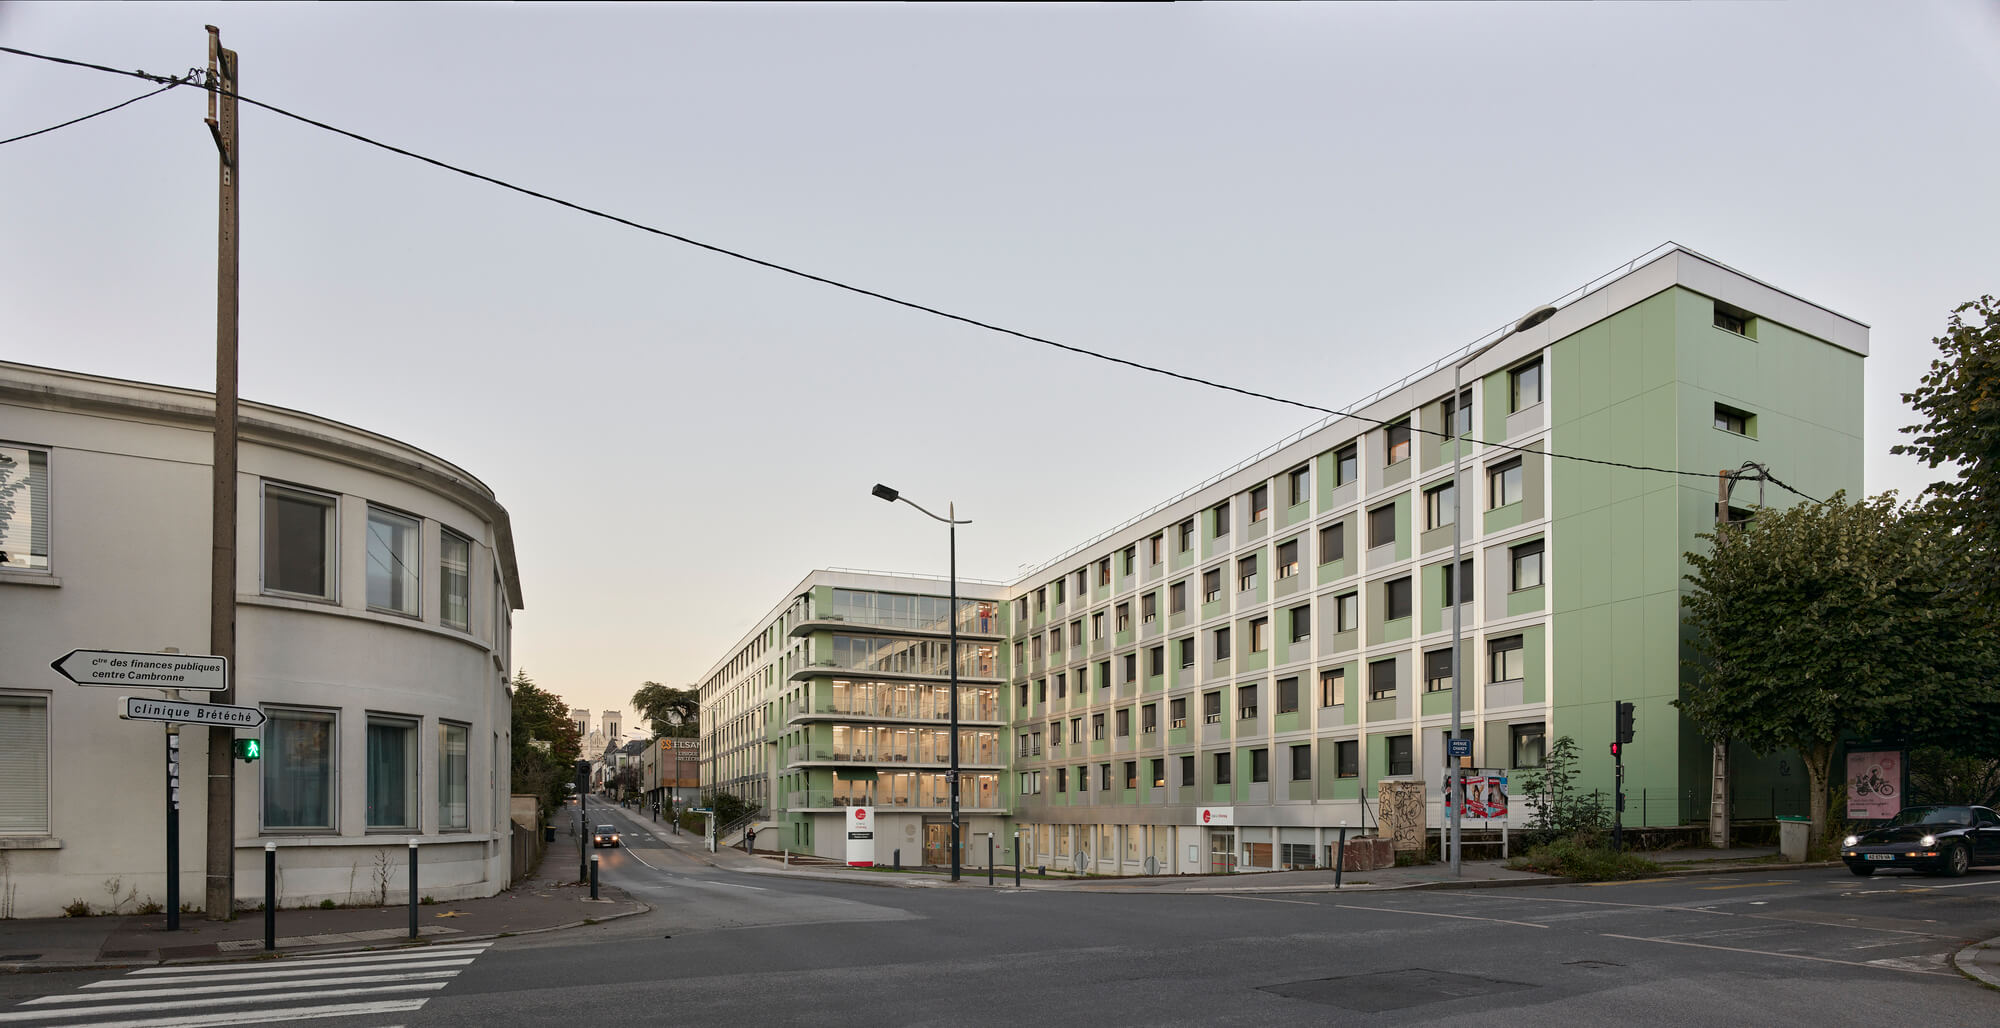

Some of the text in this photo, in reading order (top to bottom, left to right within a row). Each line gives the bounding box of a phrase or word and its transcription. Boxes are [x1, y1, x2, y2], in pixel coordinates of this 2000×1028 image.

[110, 658, 128, 668] des
[131, 659, 173, 670] finances
[174, 661, 221, 673] publiques
[92, 670, 185, 682] centre Cambronne
[134, 703, 252, 723] clinique Brétéché
